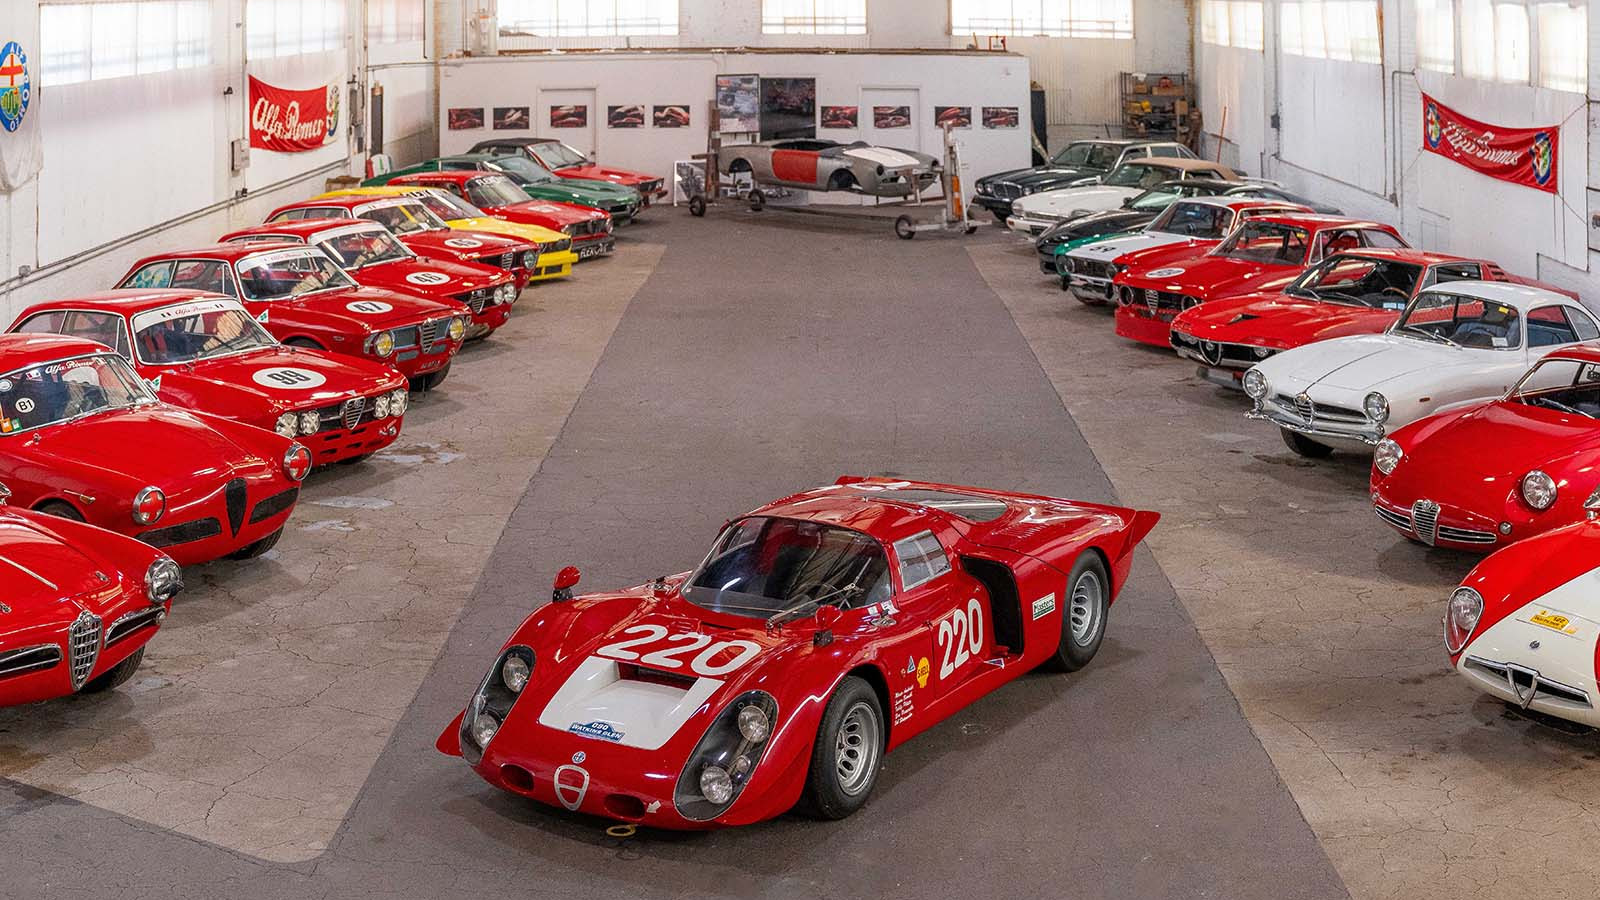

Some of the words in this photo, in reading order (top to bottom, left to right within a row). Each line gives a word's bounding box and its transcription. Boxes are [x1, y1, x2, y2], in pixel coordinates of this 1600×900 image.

[252, 97, 284, 142] Alfa
[414, 273, 442, 284] 46
[174, 307, 191, 316] Alfa
[353, 302, 382, 313] 47
[45, 363, 66, 374] Alfa
[65, 360, 94, 369] Romeo
[266, 369, 312, 386] 99
[18, 399, 33, 411] B1
[937, 598, 984, 681] 220
[596, 624, 762, 676] 220
[917, 665, 929, 679] SHELL
[571, 724, 602, 734] WATKINS
[602, 731, 622, 739] GLEN
